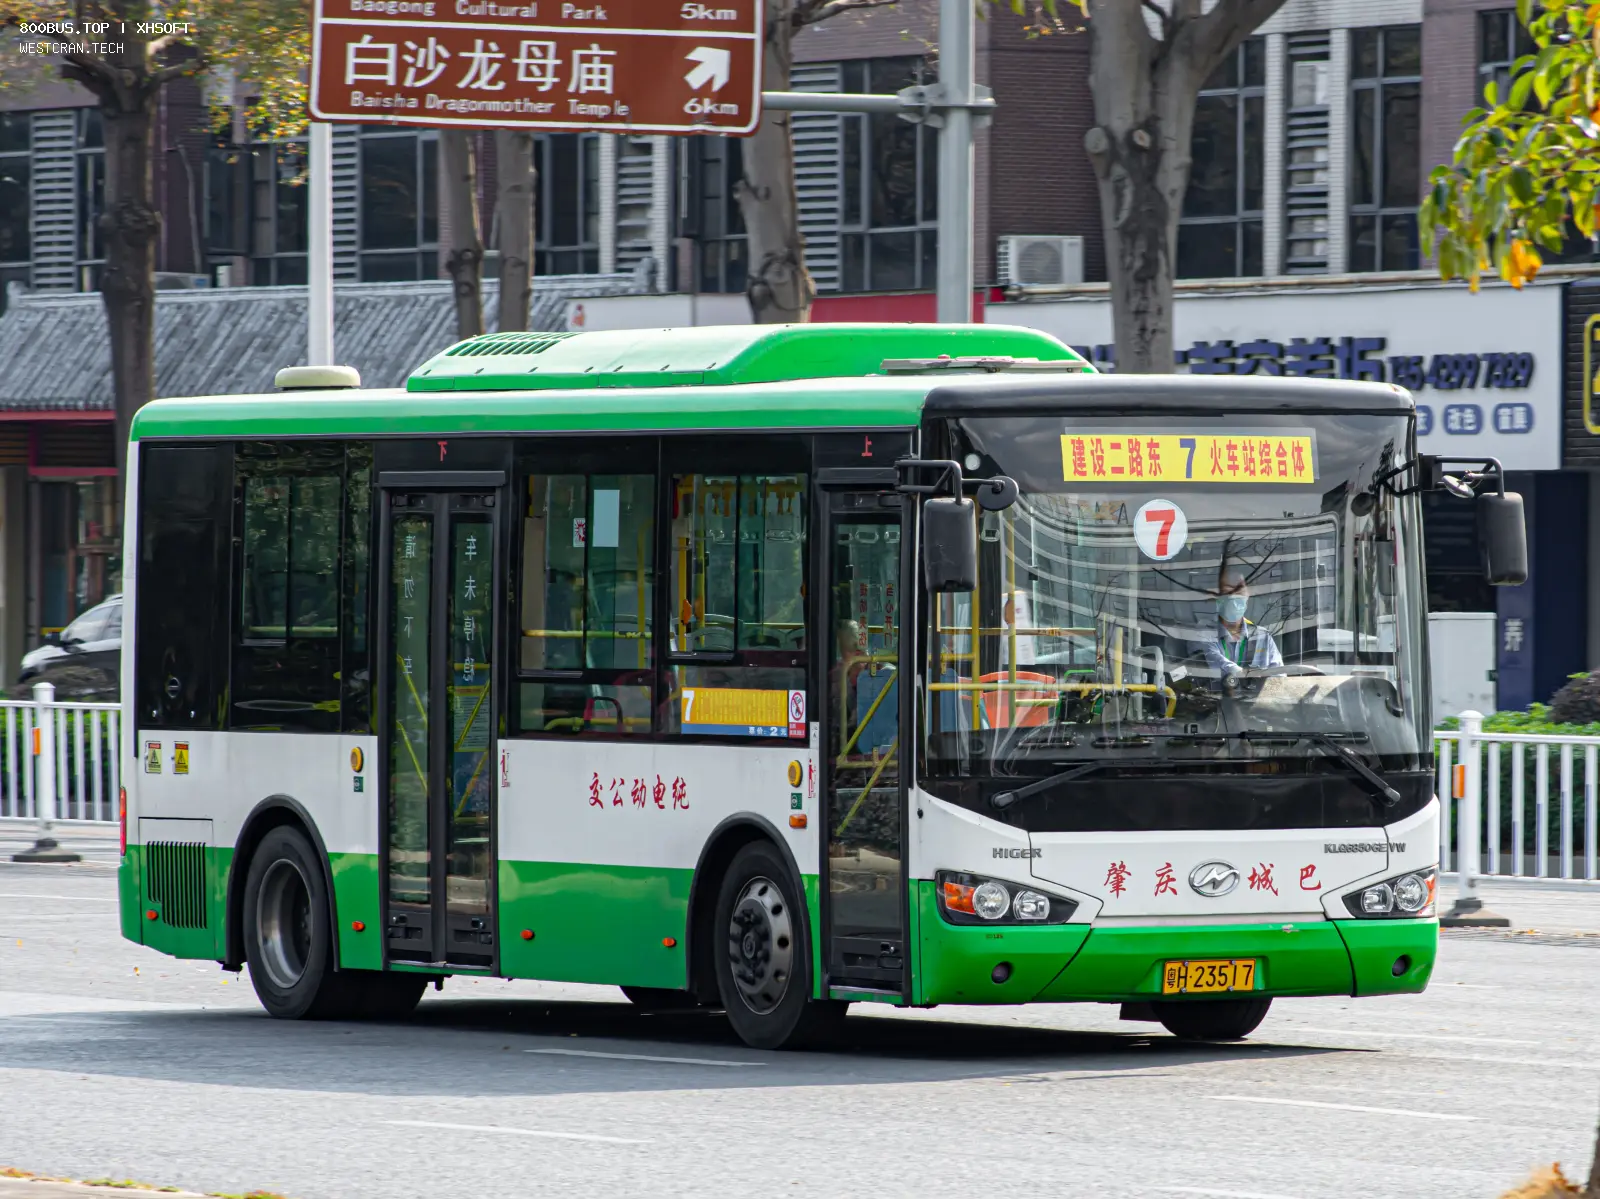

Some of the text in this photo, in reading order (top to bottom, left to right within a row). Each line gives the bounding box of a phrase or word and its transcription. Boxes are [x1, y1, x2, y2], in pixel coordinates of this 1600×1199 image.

[350, 0, 607, 20] Baogong Cultural Park
[680, 2, 738, 20] 5km
[344, 34, 617, 94] 白沙龙母庙
[350, 91, 418, 109] Baisha
[424, 94, 556, 114] Dragonmother
[683, 97, 739, 115] 6km
[1070, 437, 1305, 479] 建设二路东 7 火车站综合体
[1145, 509, 1176, 557] 7
[682, 690, 696, 722] 7
[992, 847, 1043, 859] HIGER
